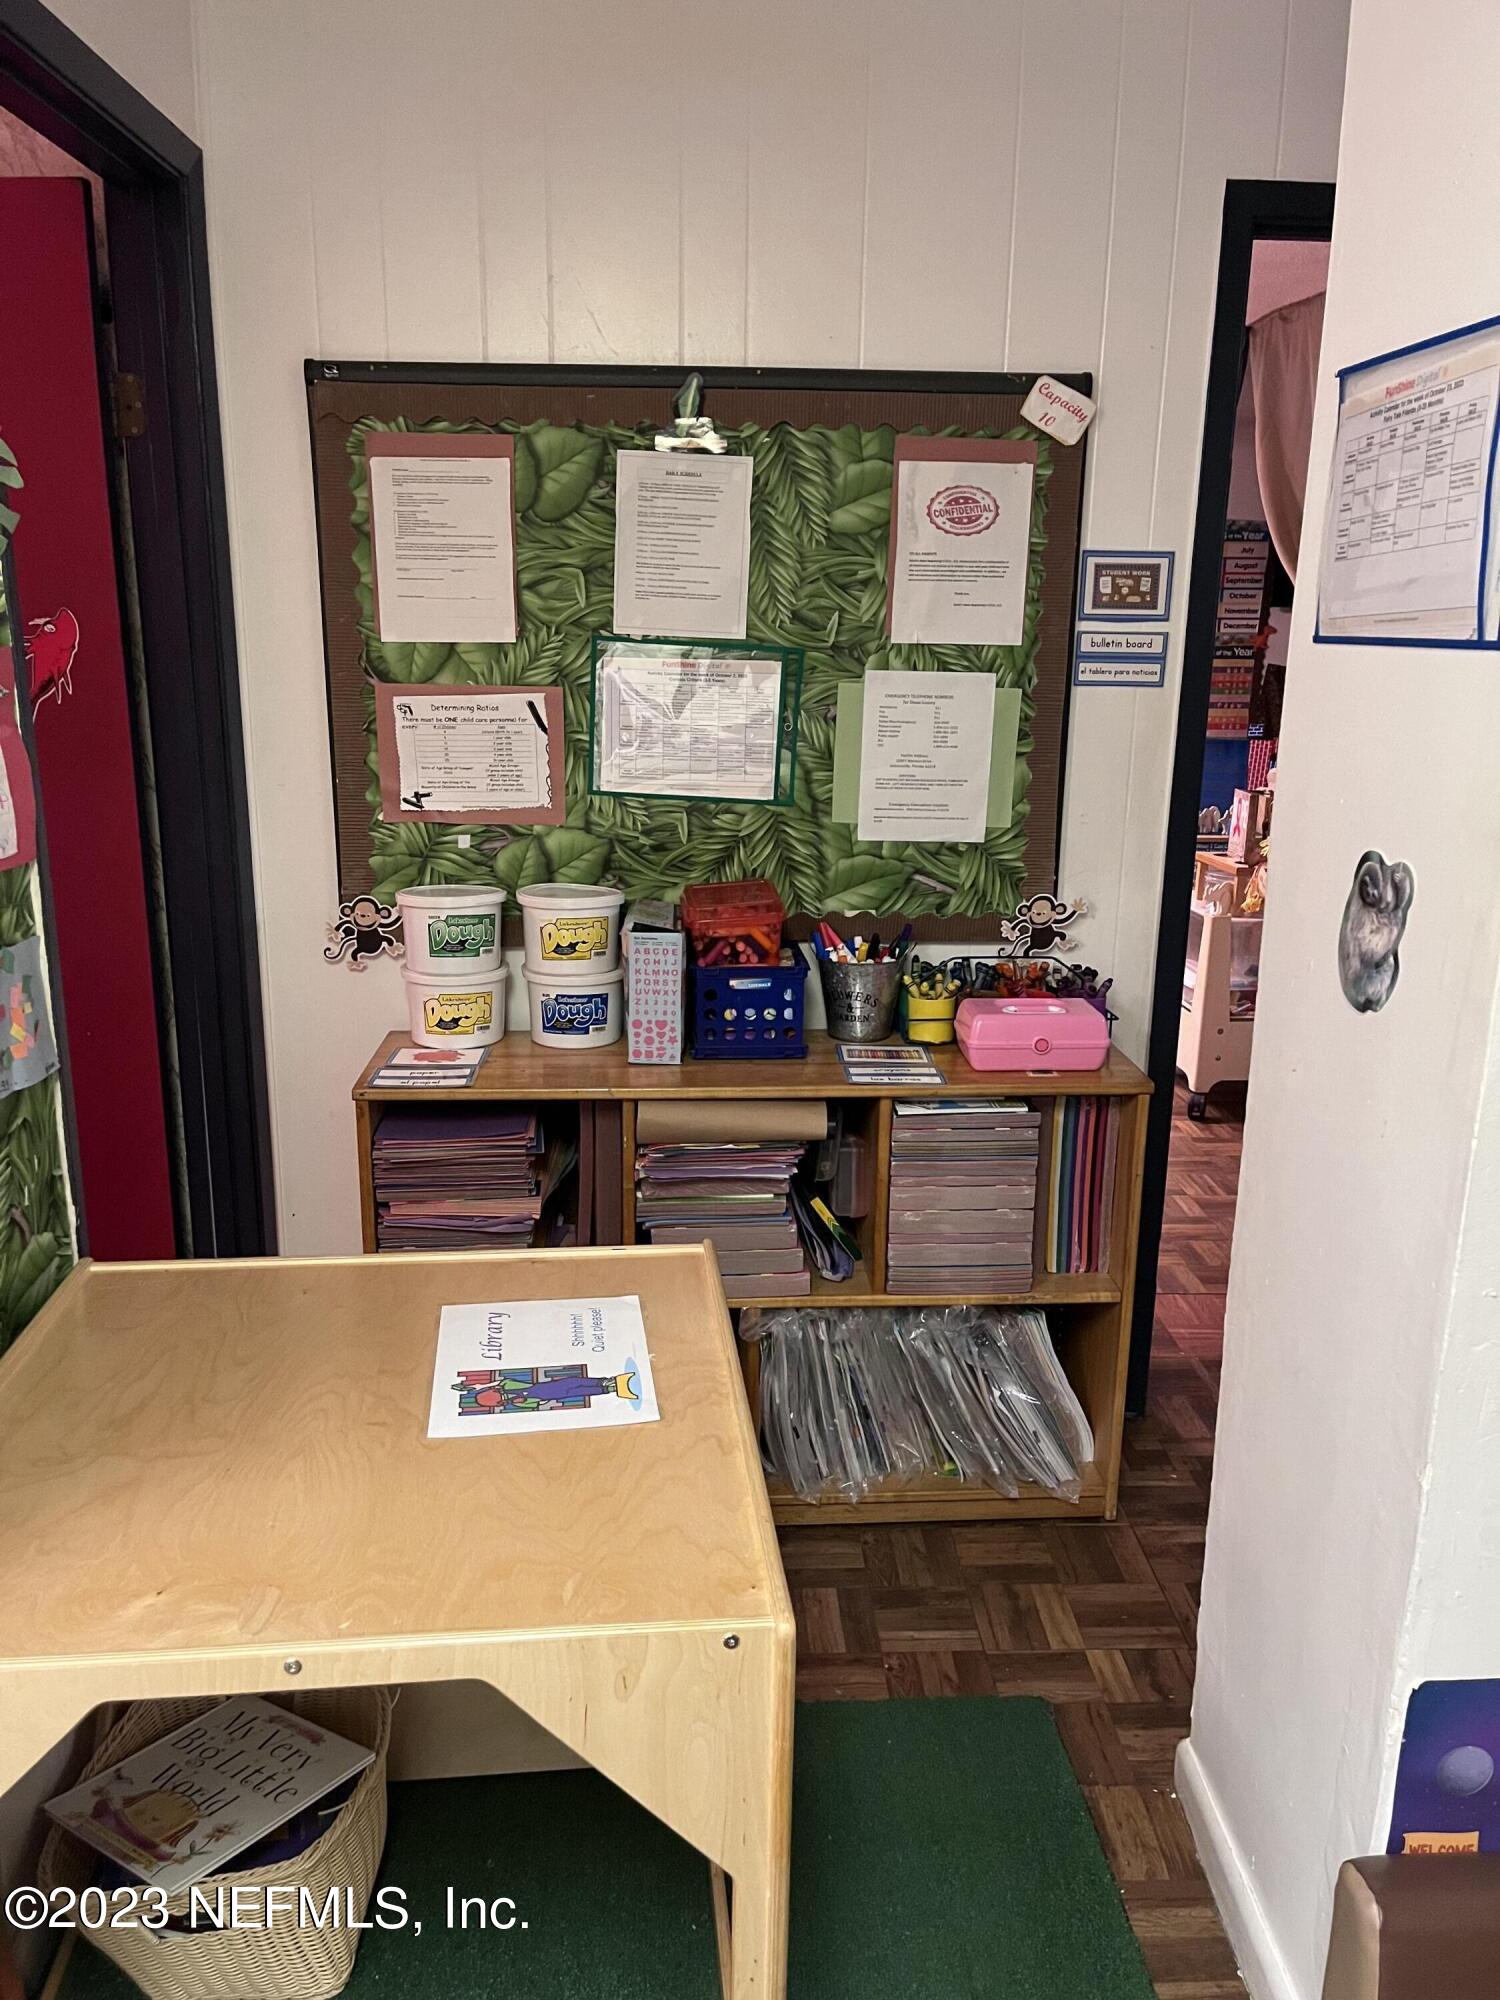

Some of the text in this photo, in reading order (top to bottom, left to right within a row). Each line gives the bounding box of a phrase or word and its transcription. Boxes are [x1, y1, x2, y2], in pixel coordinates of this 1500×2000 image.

[1038, 382, 1089, 423] Capacity
[1038, 412, 1056, 427] 10
[933, 503, 993, 518] CONFIDENTIAL
[1234, 562, 1258, 570] August
[1225, 577, 1262, 585] September
[1090, 637, 1153, 649] bulletin board
[1233, 647, 1253, 656] Year
[1088, 667, 1112, 675] tablero
[1114, 669, 1130, 678] para
[430, 704, 500, 713] Determining Ratios
[489, 717, 517, 725] personnel
[429, 919, 495, 951] Dough
[541, 921, 607, 954] Dough
[826, 990, 879, 1008] LOWERS
[424, 996, 491, 1028] Dough
[542, 997, 607, 1027] Dough
[846, 1002, 855, 1013] &
[833, 1013, 870, 1022] ARDEN
[479, 1311, 511, 1361] Library
[588, 1307, 607, 1353] Quiet please!
[220, 1709, 260, 1745] My
[256, 1727, 318, 1774] Very
[171, 1727, 225, 1770] Big
[221, 1750, 299, 1803] Little
[151, 1762, 241, 1818] World
